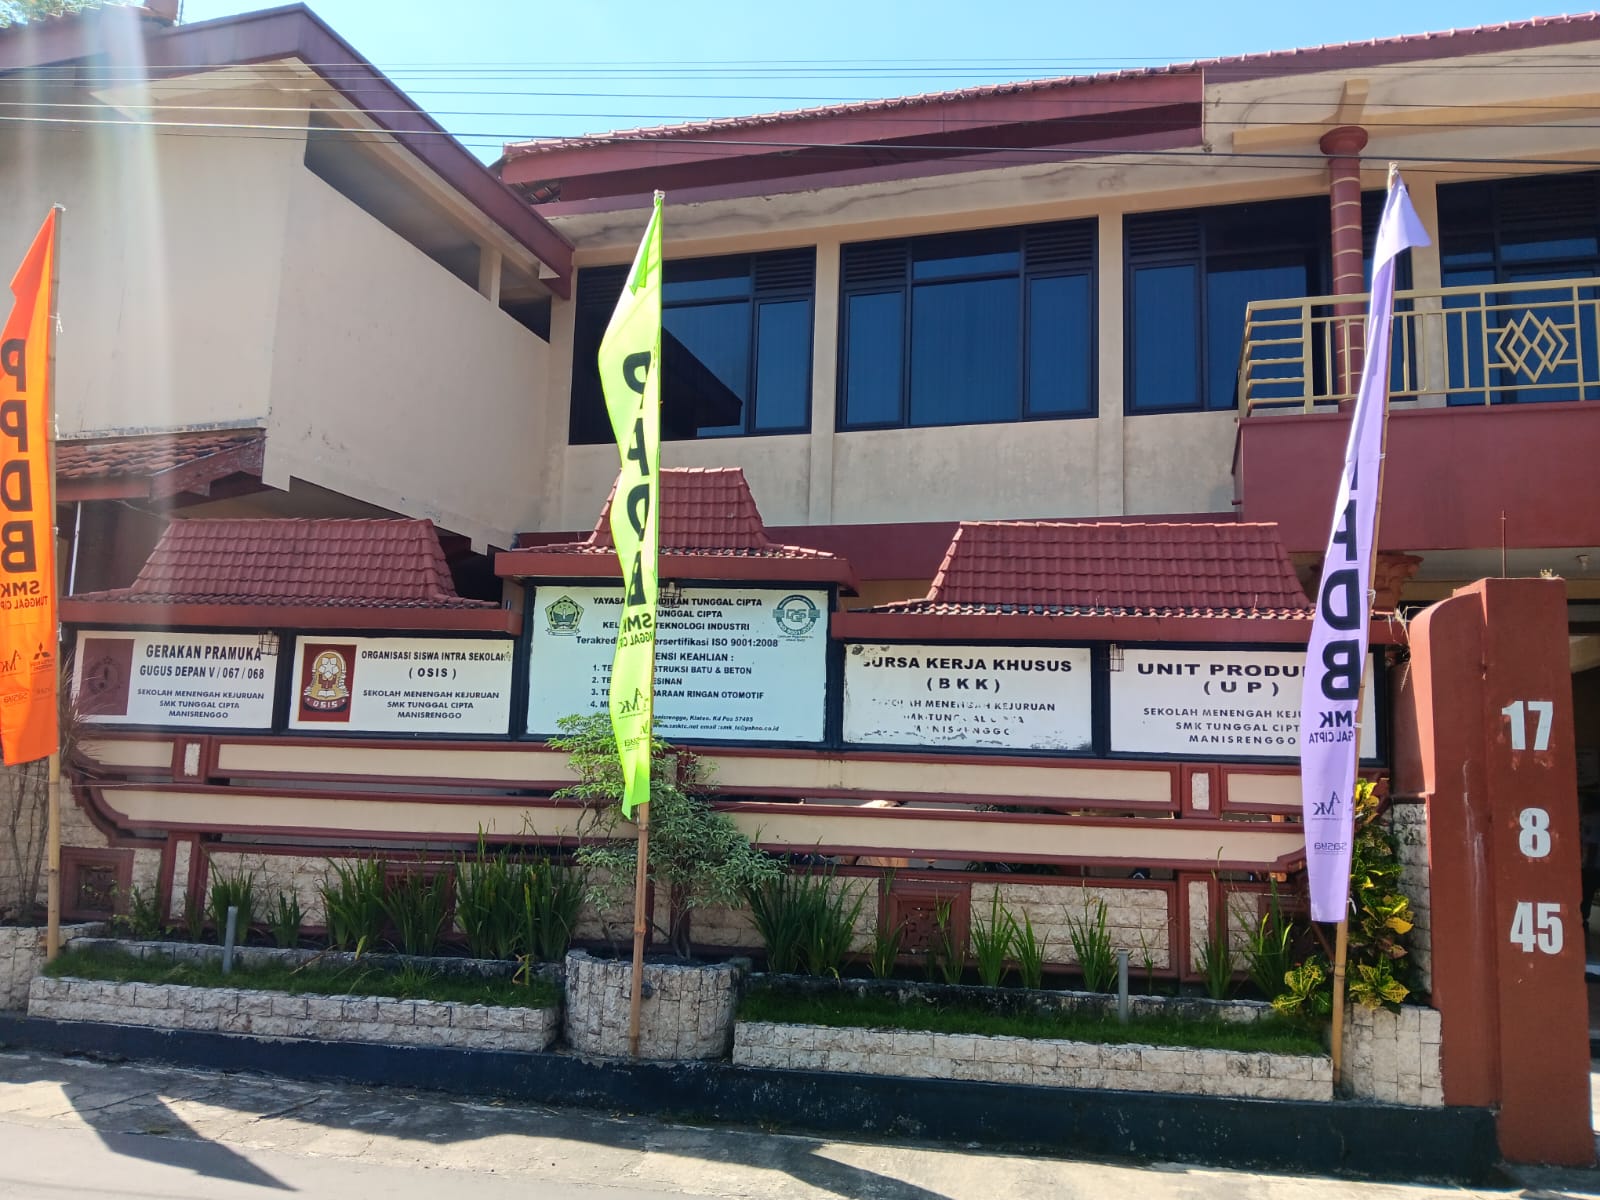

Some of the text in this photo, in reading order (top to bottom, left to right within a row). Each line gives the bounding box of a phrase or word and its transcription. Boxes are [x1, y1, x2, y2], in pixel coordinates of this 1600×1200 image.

[655, 637, 708, 646] ersertifikasi
[730, 639, 778, 648] 9001:2008
[146, 644, 262, 661] GERAKAN PRAMUKA
[362, 650, 411, 660] ORGANISASI
[414, 652, 439, 660] SISWA
[441, 652, 466, 661] INTRA
[680, 653, 728, 661] KEAHLIAN
[926, 658, 986, 670] KERJA
[993, 659, 1072, 672] KHUSUS
[1138, 663, 1306, 678] UNIT PRODU
[140, 664, 172, 677] GUGUS
[175, 666, 206, 678] DEPAN
[209, 667, 216, 678] V
[222, 667, 240, 678] 067
[248, 668, 264, 680] 068
[137, 688, 264, 700] SEKOLAH MENENGAH KEJURUAN
[363, 690, 500, 699] SEKOLAH MENENGAH KEJURUAN
[178, 700, 216, 708] TUNGGAL
[312, 700, 338, 709] OSIS
[168, 710, 228, 718] MANISRENGGO
[397, 711, 462, 719] MANISRENGGO
[1144, 708, 1198, 717] SEKOLAH
[1202, 708, 1272, 718] MENENGAH
[1176, 722, 1300, 732] SMK TUNGGAL CIPT
[1502, 700, 1554, 750] 17
[1189, 735, 1296, 744] MANISRENGGO
[1519, 808, 1551, 858] 8
[1510, 902, 1564, 954] 45
